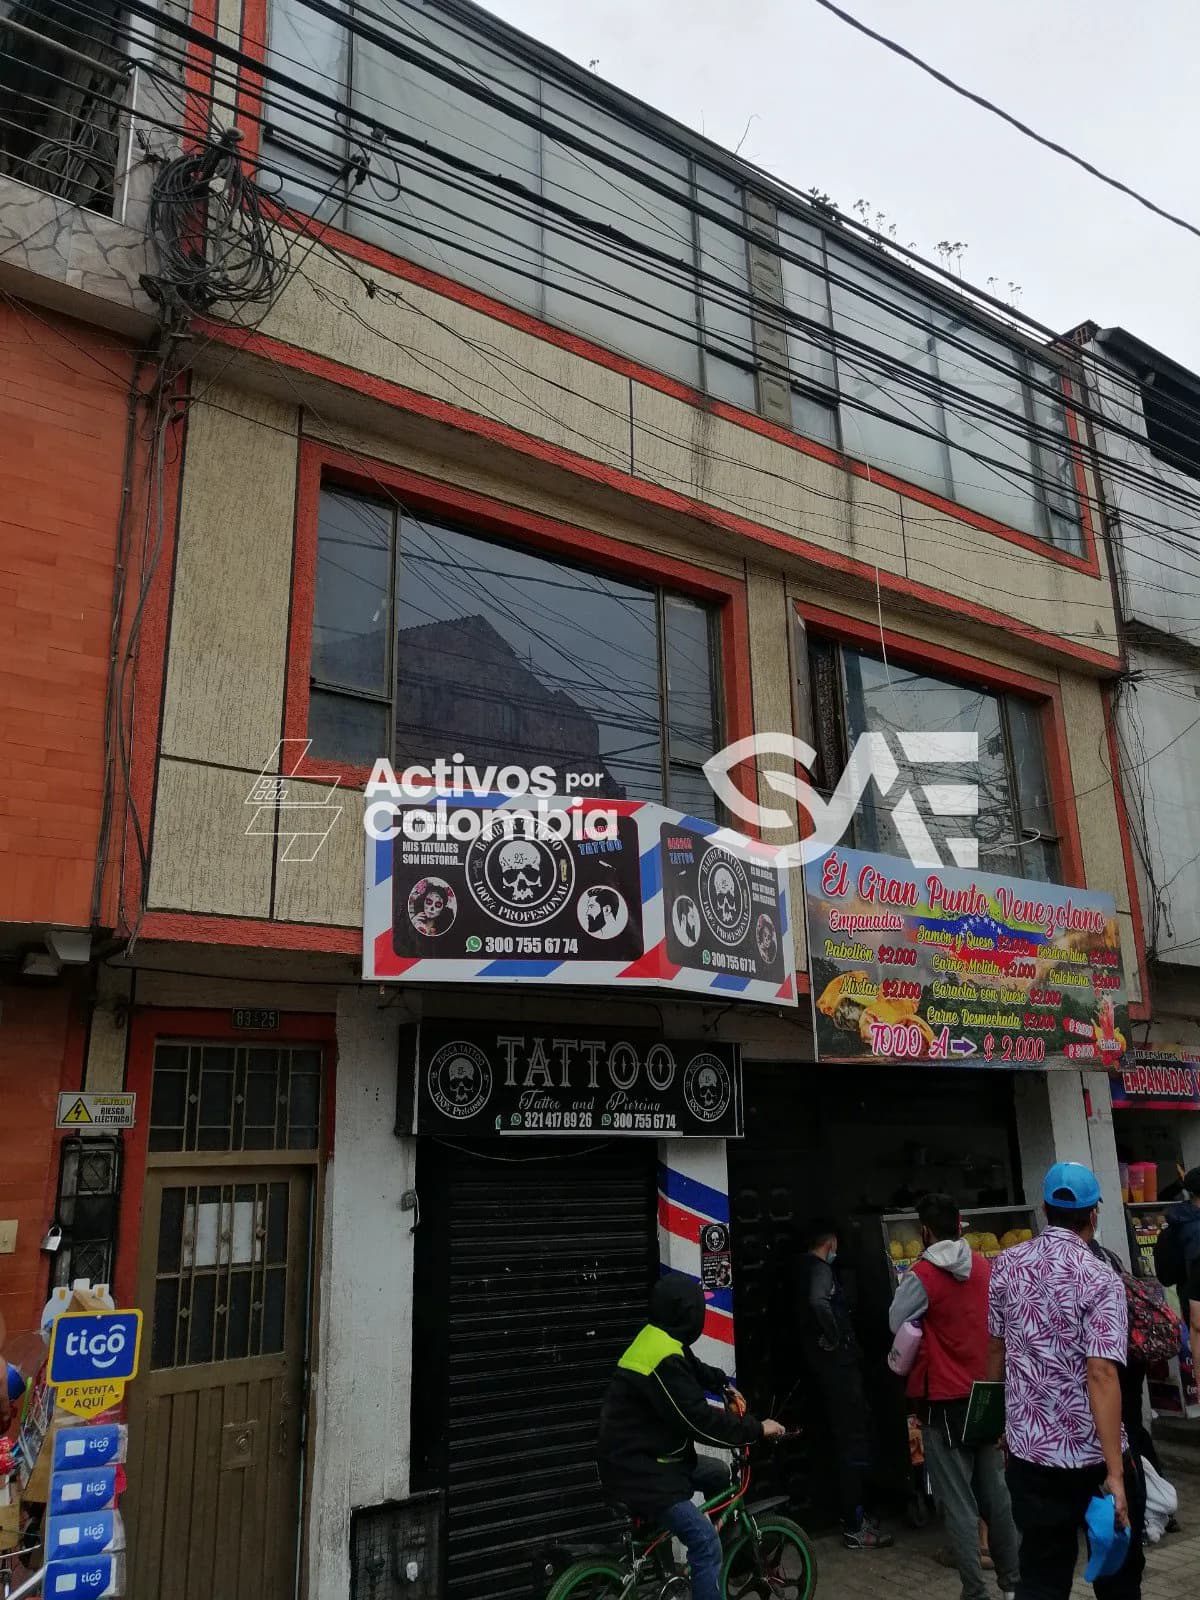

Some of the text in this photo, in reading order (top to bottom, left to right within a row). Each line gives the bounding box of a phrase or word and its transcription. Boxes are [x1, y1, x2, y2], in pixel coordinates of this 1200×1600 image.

[403, 842, 458, 853] MIS TATUAJES
[578, 839, 623, 855] TATTOO
[403, 854, 419, 864] SON
[473, 881, 569, 922] 100% PROFESIONAL
[822, 852, 1105, 939] Él Gran Punto Venezolano
[829, 909, 904, 938] Empanadas
[485, 937, 578, 954] 300 755 67 74
[917, 925, 952, 945] Jamón
[953, 932, 963, 952] y
[966, 930, 994, 950] Queso
[711, 951, 725, 968] 300
[726, 953, 740, 970] 755
[824, 939, 917, 966] Pabellón $2.000
[931, 954, 964, 973] Carne
[969, 958, 1000, 976] Molida
[839, 976, 922, 1000] Mixtas $2.000
[1050, 968, 1090, 989] Salchicha
[980, 988, 998, 1002] con
[1000, 985, 1026, 1004] Queso
[927, 1005, 959, 1025] Carne
[961, 1008, 1020, 1029] Desmechada
[870, 1022, 1046, 1062] TODO A $ 2.000
[496, 1036, 677, 1090] TATTOO
[1123, 1065, 1193, 1096] EMPANADAS
[518, 1089, 561, 1110] Tattoo
[572, 1096, 595, 1110] and
[94, 1115, 130, 1123] ELECTRICO
[100, 1107, 125, 1115] RIESGO
[524, 1112, 593, 1128] 321 417 89 26
[613, 1114, 676, 1129] 300 755 67 74
[65, 1384, 115, 1397] DE VENTA
[74, 1394, 105, 1408] AQUÍ
